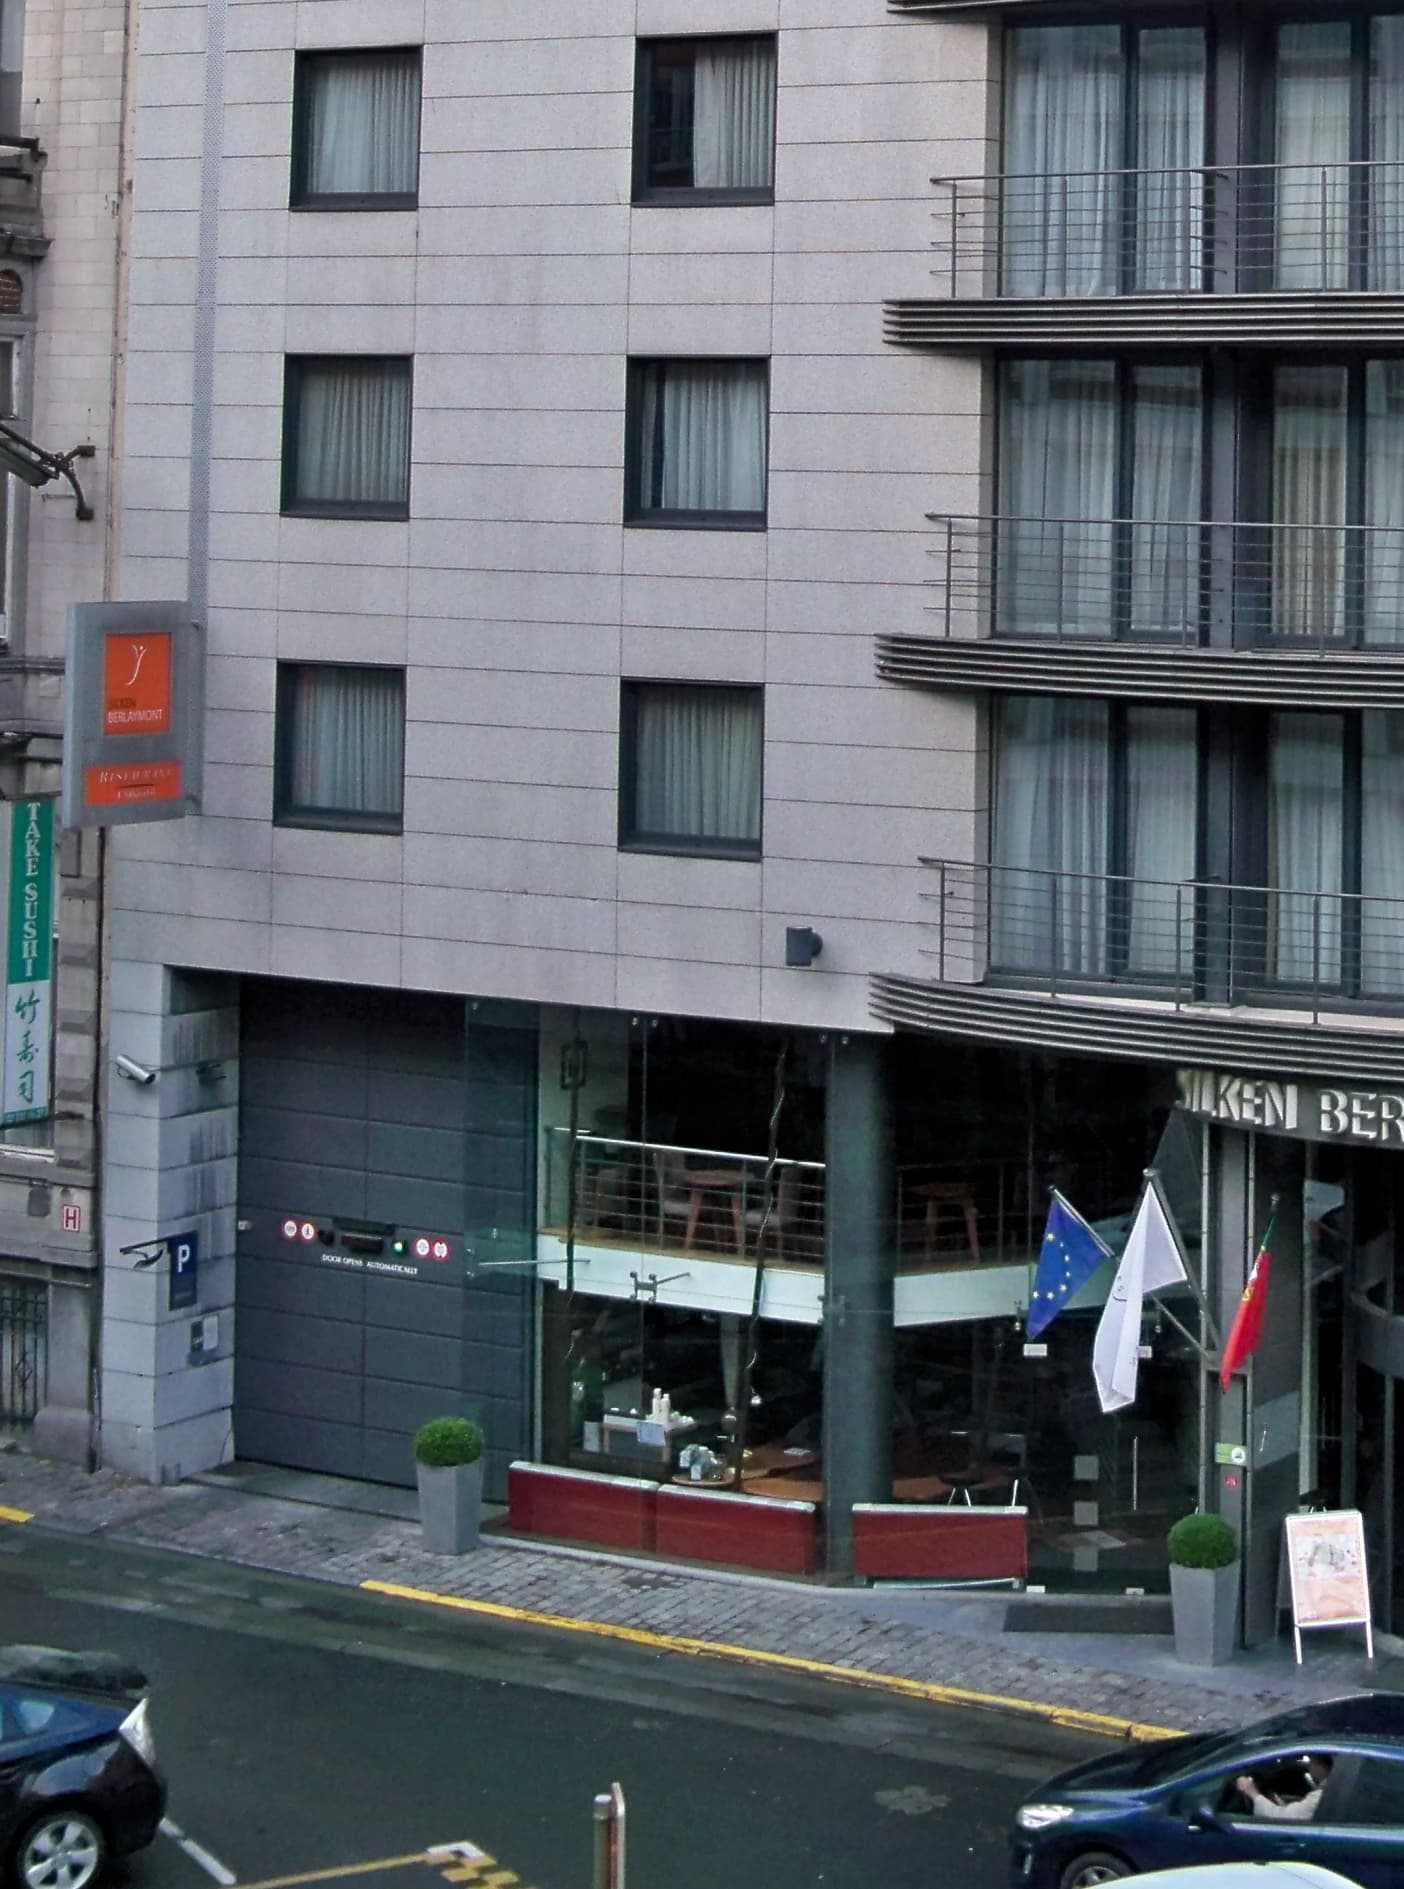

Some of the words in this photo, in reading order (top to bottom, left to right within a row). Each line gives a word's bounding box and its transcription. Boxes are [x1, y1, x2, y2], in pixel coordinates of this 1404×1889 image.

[107, 709, 163, 724] BERLAYMONT
[25, 802, 41, 877] TAKE
[22, 882, 39, 977] SUSHI
[64, 1207, 78, 1229] H
[177, 1243, 191, 1273] P
[322, 1253, 342, 1263] DOOR
